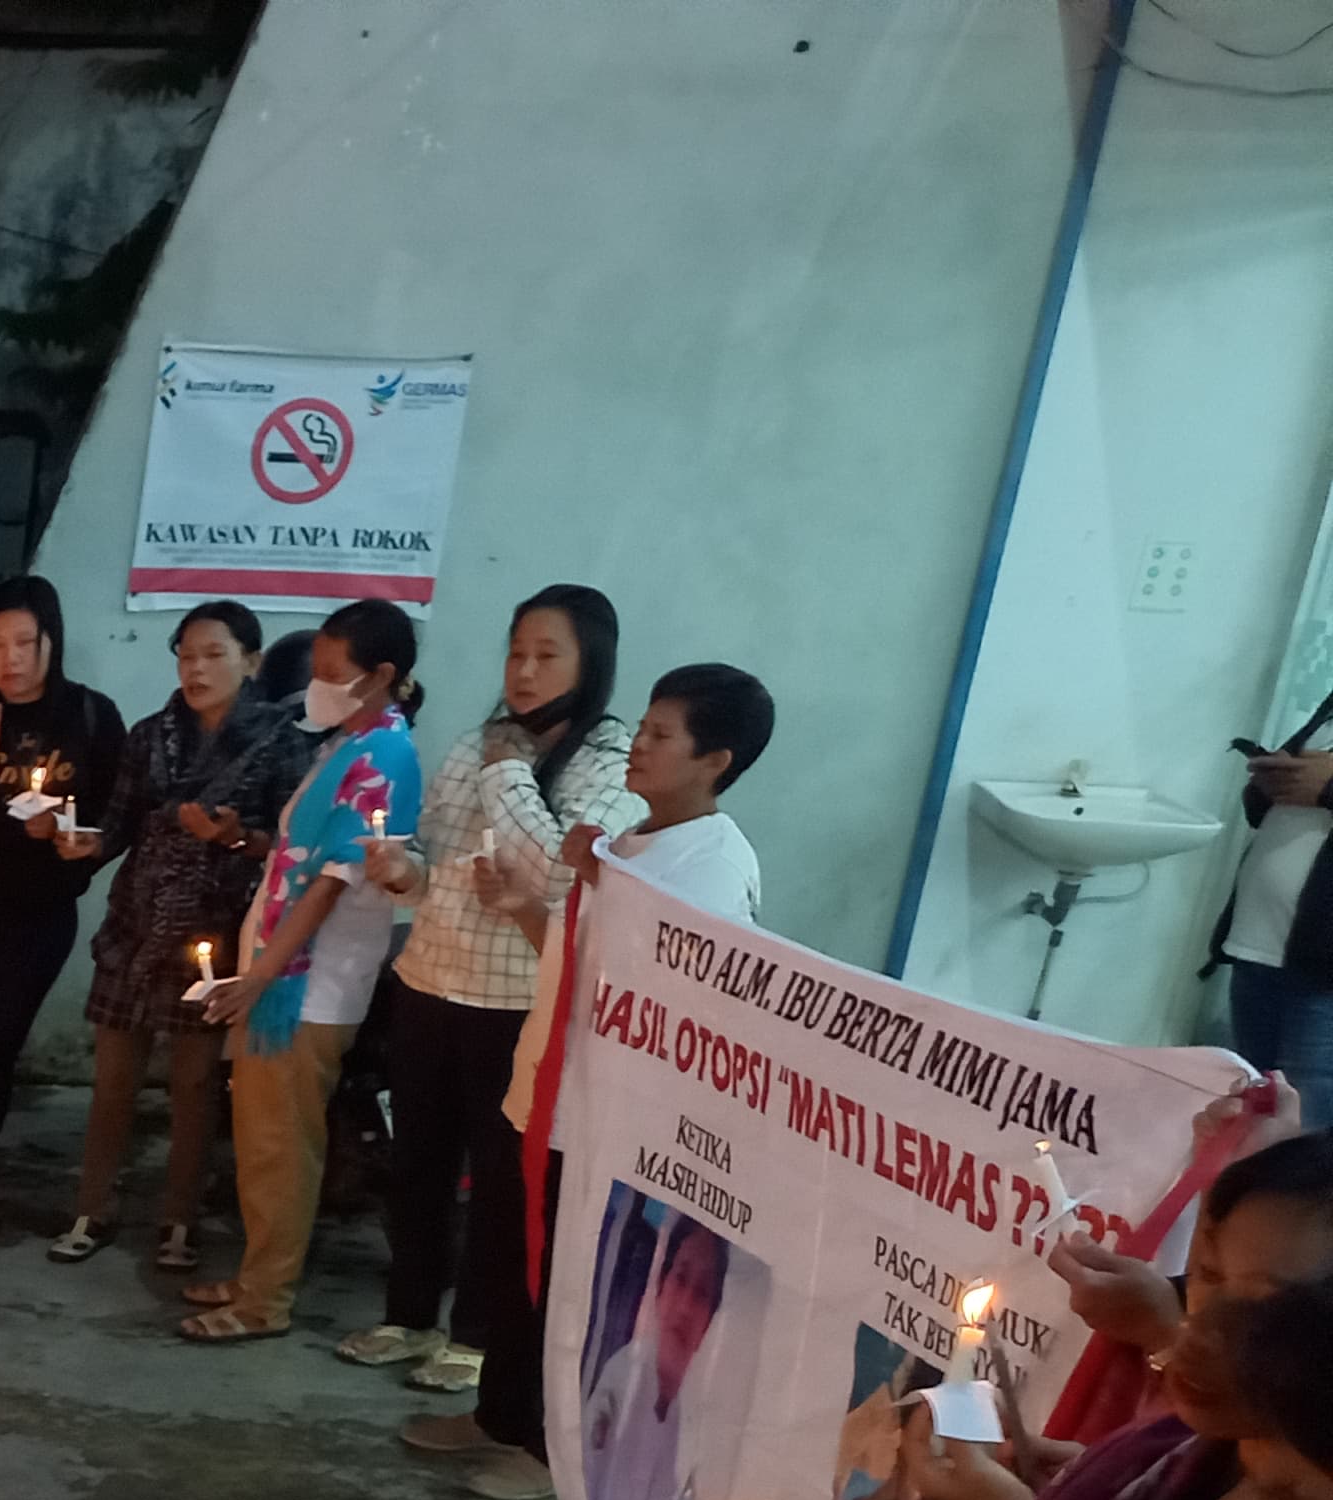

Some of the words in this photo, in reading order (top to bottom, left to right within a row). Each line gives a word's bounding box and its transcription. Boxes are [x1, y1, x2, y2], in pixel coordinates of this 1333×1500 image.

[144, 522, 257, 545] KAWASAN
[269, 525, 340, 548] TANPA
[352, 528, 432, 551] ROKOK
[656, 920, 716, 982] FOTO
[713, 947, 779, 1011] ALM.
[774, 970, 837, 1030] IBU
[823, 990, 926, 1074] BERTA
[916, 1029, 1010, 1112] MIMI
[997, 1064, 1099, 1156] JAMA
[586, 978, 669, 1061] HASIL
[675, 1016, 772, 1115] OTOPSI
[873, 1111, 1001, 1232] LEMAS
[675, 1114, 732, 1174] KETIKA
[634, 1146, 699, 1203] MASIH
[698, 1178, 753, 1234] HIDUP
[873, 1236, 937, 1299] PASCA
[884, 1292, 922, 1342] TAK
